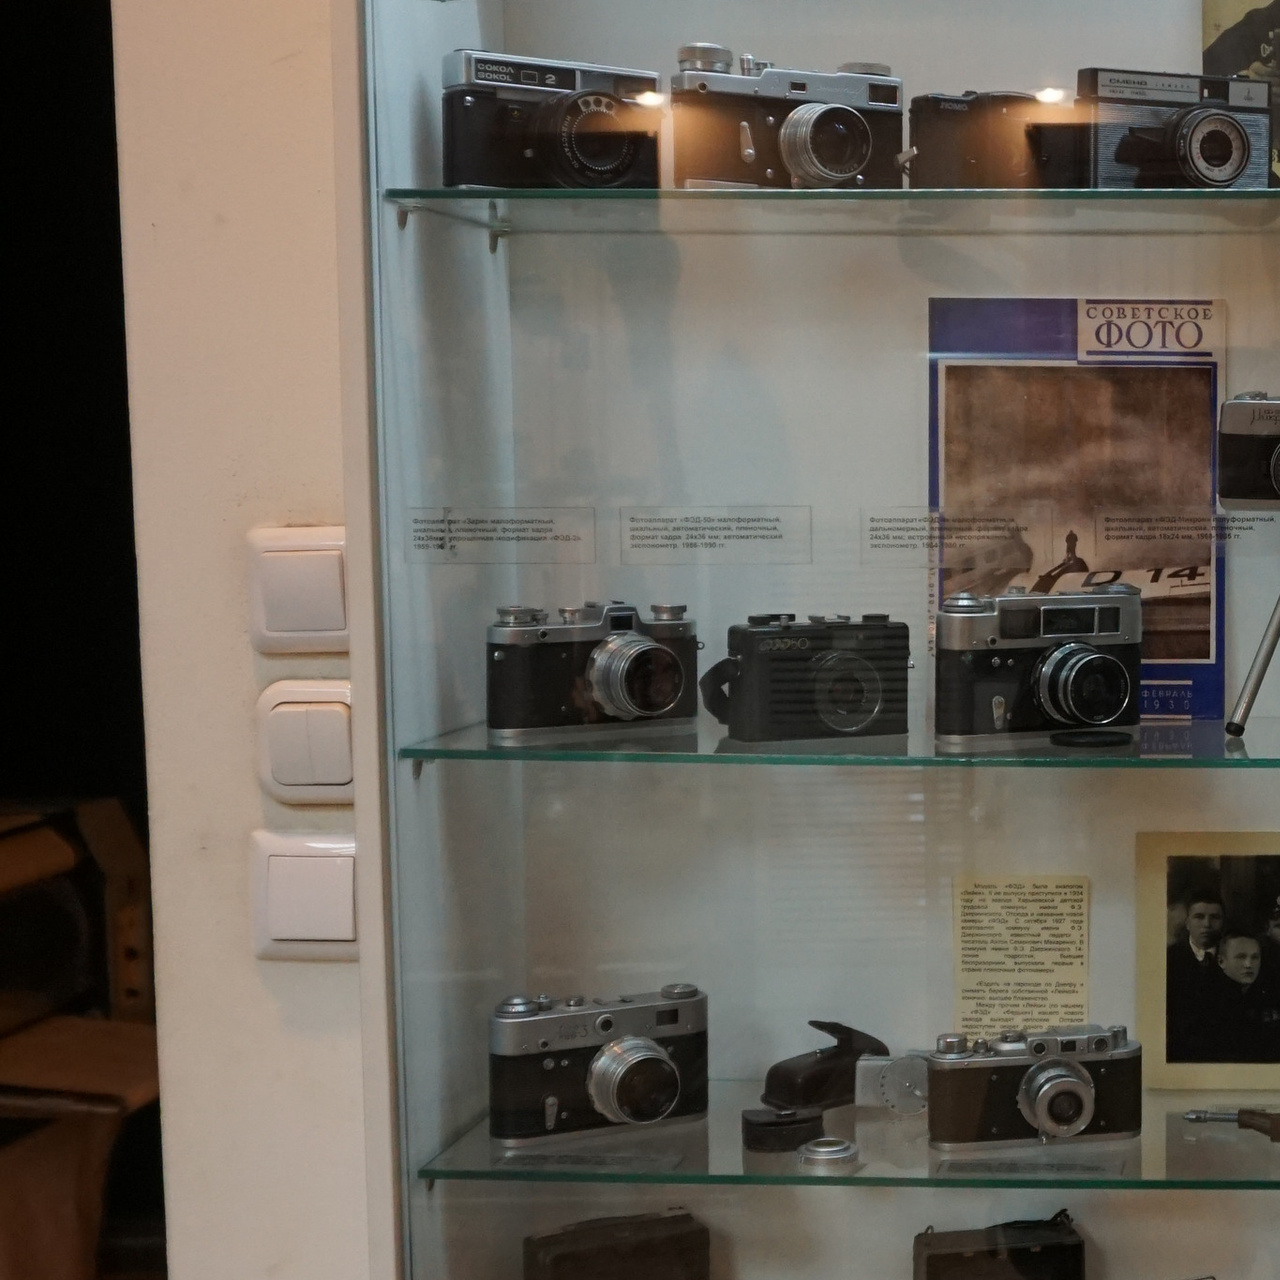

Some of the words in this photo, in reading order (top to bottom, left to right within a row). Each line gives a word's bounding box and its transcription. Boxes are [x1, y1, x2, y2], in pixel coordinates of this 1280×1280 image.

[477, 63, 513, 73] СОКОЛ
[477, 71, 512, 82] SOKOL
[545, 75, 555, 84] 2
[940, 101, 968, 111] ЛОМО
[1086, 307, 1214, 320] СОВЕТСКОЕ
[1095, 320, 1203, 349] ФОТО
[630, 533, 658, 541] формат
[1105, 533, 1133, 541] формат
[1146, 566, 1206, 583] 14
[1141, 689, 1193, 699] ФЕВРАЛЬ
[1144, 700, 1190, 710] 1930
